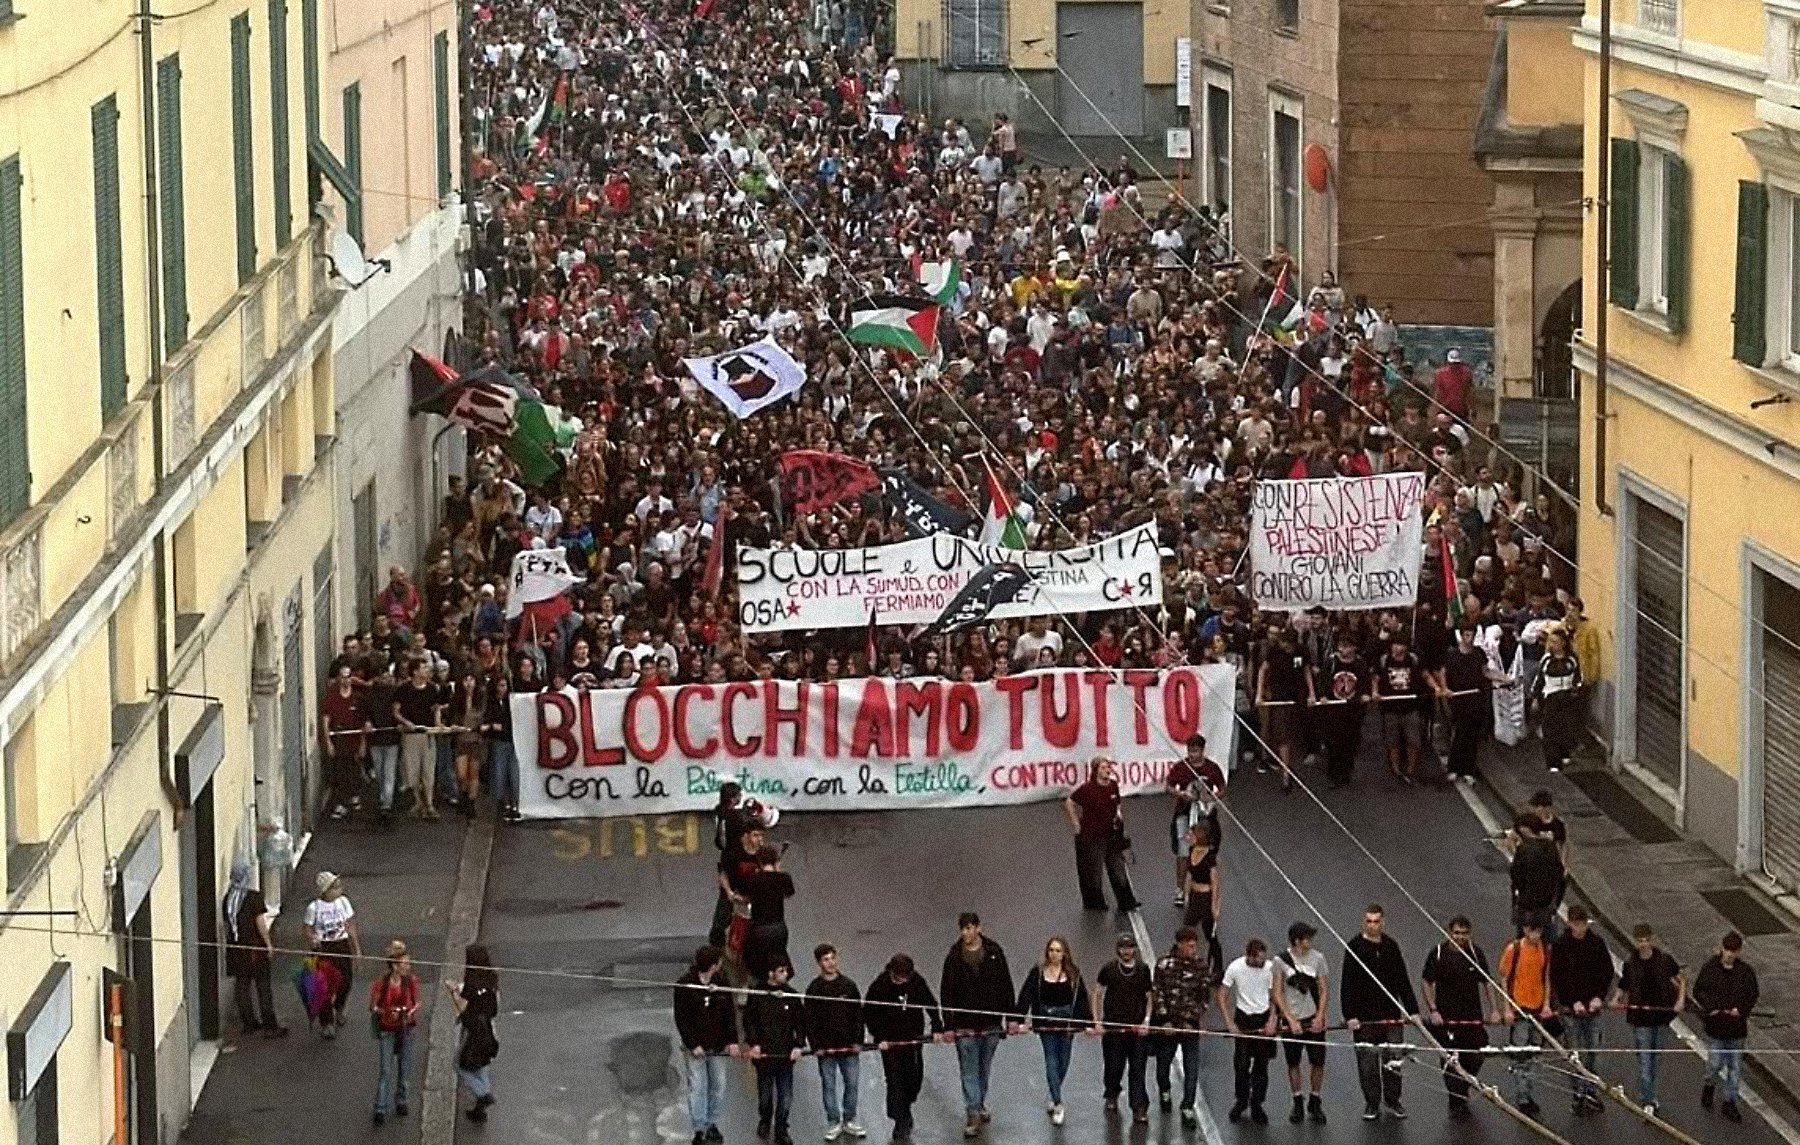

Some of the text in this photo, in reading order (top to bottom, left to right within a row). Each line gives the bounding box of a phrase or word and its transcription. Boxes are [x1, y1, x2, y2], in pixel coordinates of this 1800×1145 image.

[1254, 483, 1292, 510] CON
[1293, 475, 1424, 530] RESISTENZA
[1266, 525, 1389, 556] PALESTINESE
[739, 549, 882, 584] SCUOLE
[900, 559, 919, 575] e
[1291, 553, 1364, 576] GIOVANI
[786, 578, 828, 599] CON
[836, 577, 862, 597] LA
[927, 572, 960, 592] CON
[1253, 568, 1412, 601] CONTRO LA GUERRA
[741, 597, 787, 626] OSA
[863, 593, 946, 614] FERMIAMO
[535, 669, 1201, 770] BLOCCHIAMO TUTTO
[545, 772, 620, 800] con
[631, 765, 670, 798] la
[803, 775, 847, 797] con
[856, 763, 889, 796] la
[990, 760, 1078, 791] CONTRO
